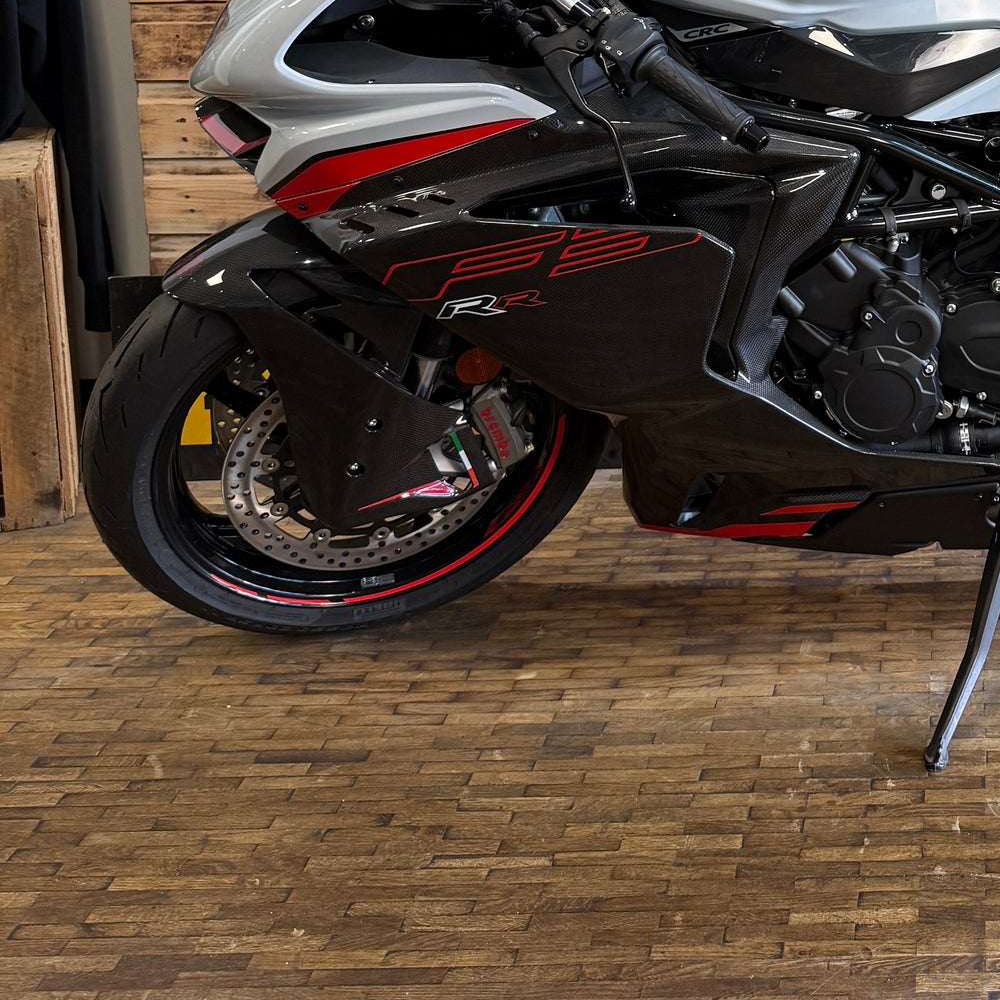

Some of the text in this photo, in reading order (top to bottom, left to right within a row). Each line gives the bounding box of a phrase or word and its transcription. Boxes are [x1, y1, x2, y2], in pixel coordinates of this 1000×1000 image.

[683, 23, 731, 39] CRC
[436, 289, 548, 320] RR
[479, 405, 511, 460] brembo
